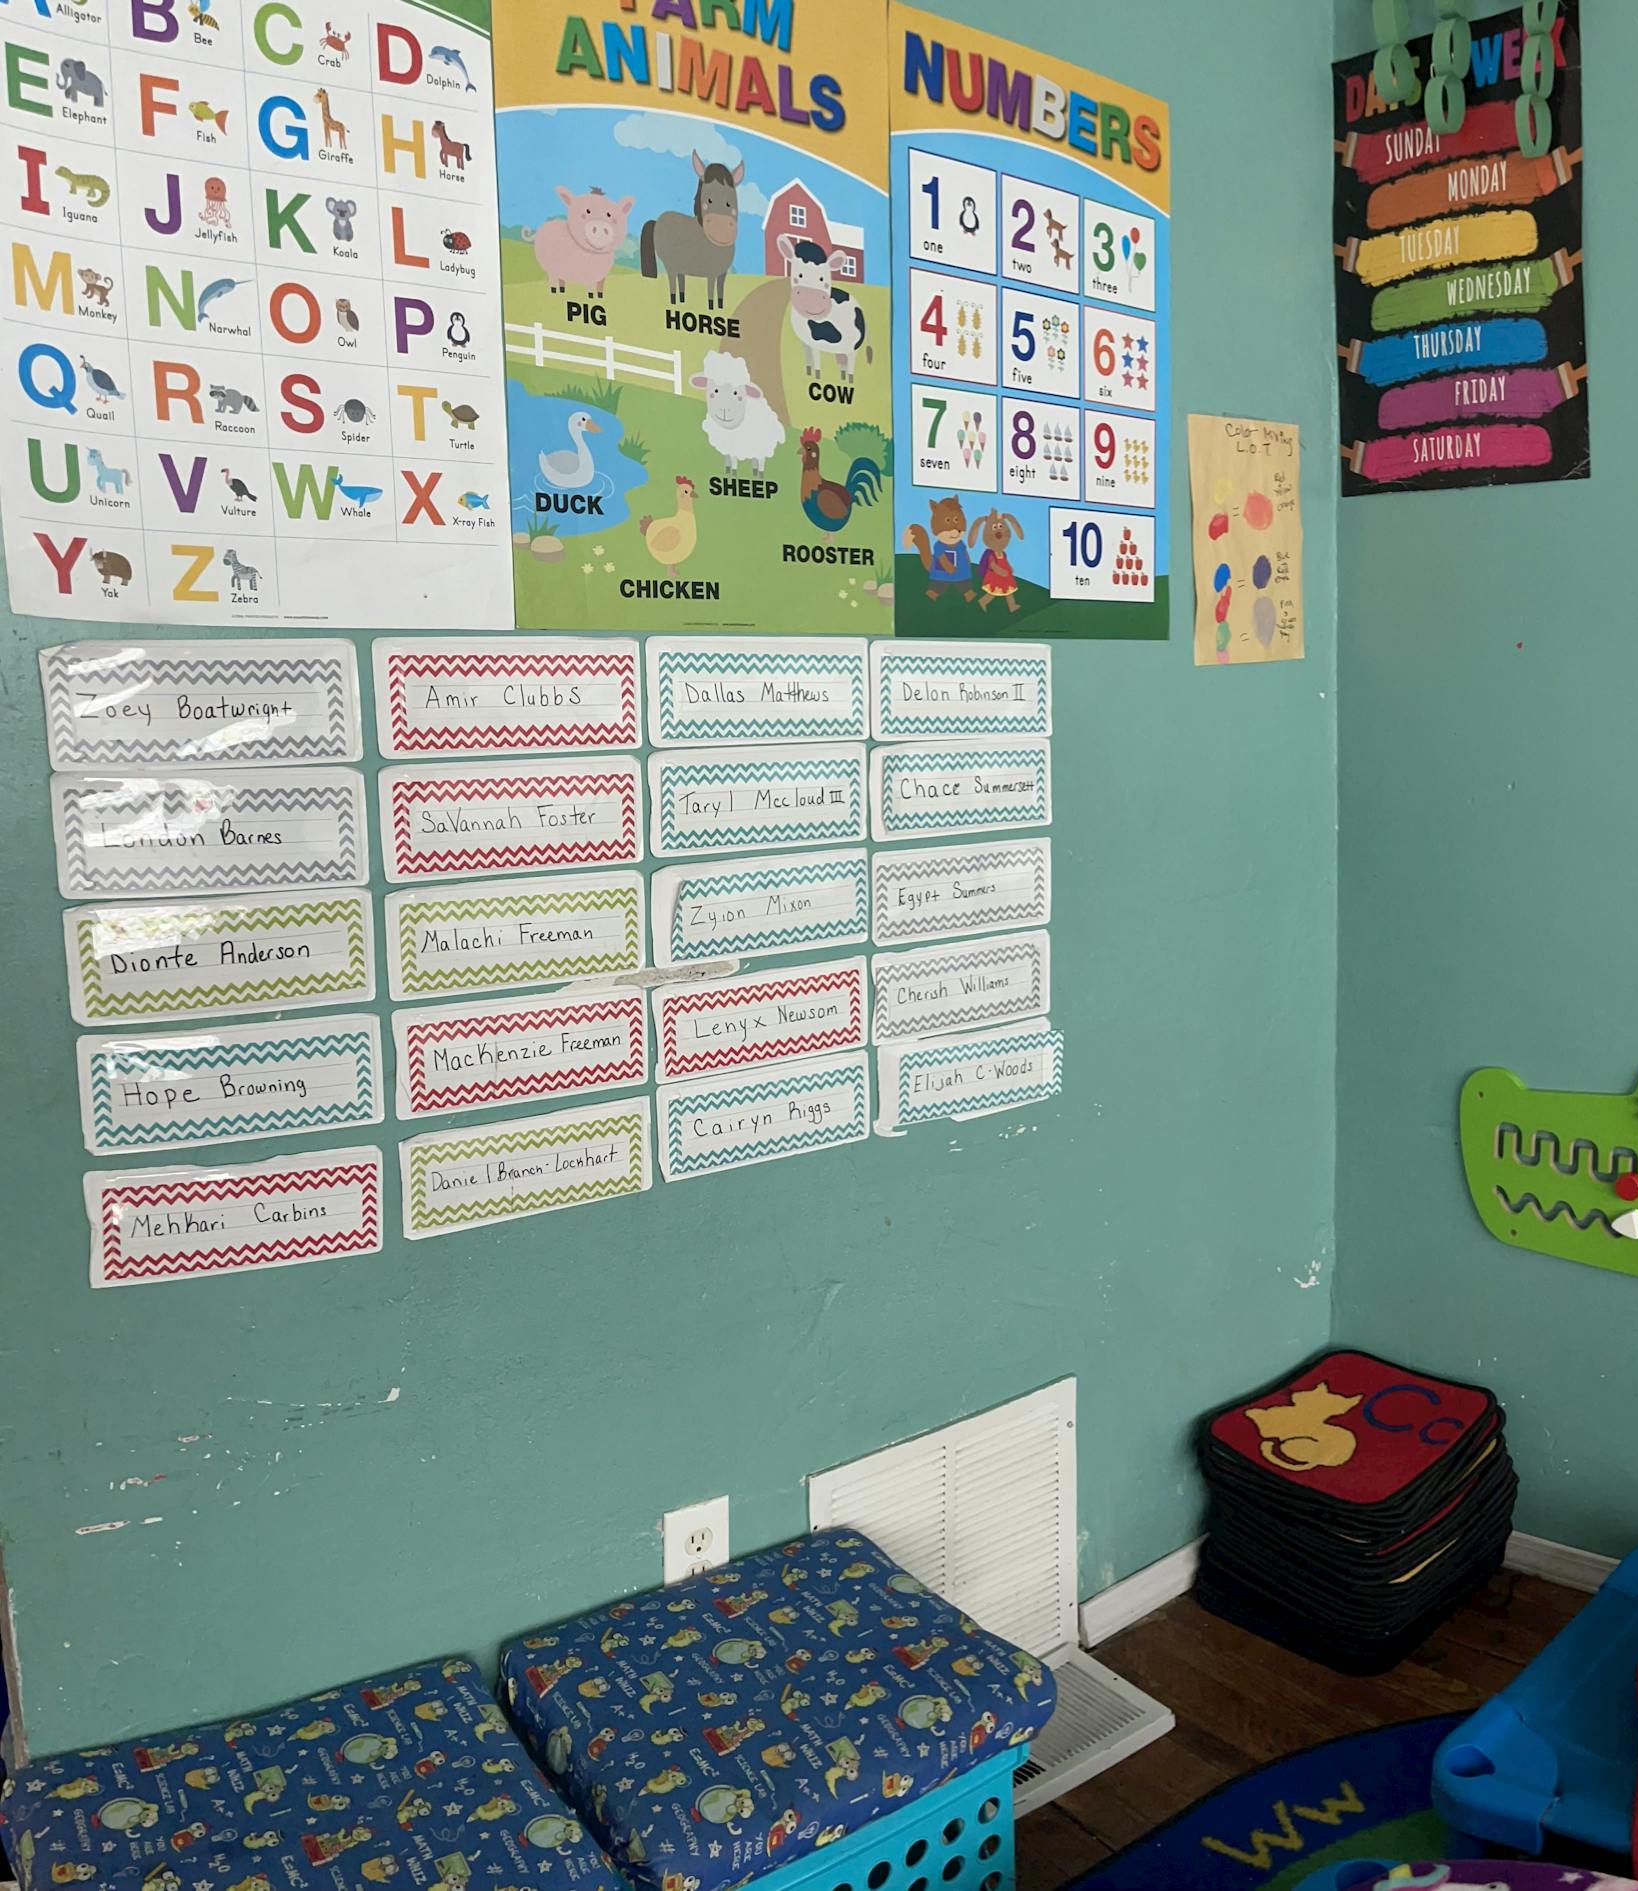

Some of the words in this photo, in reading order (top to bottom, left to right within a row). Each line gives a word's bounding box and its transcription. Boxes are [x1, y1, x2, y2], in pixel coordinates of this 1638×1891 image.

[56, 4, 102, 24] Alligator
[194, 34, 213, 46] Bee
[318, 55, 342, 68] Crab
[426, 74, 460, 92] Dolphin
[556, 16, 845, 132] ANIMALS
[903, 31, 1161, 171] NUMBERS
[62, 107, 107, 126] Elephant
[196, 131, 217, 144] Fish
[319, 150, 354, 165] Giraffe
[439, 170, 465, 183] Horse
[1448, 161, 1507, 202] MONDAY
[63, 206, 98, 224] Iguana
[195, 226, 238, 244] Jellyfish
[334, 247, 358, 259] Koala
[922, 240, 944, 254] one
[1400, 227, 1461, 263] TUESDAY
[440, 261, 476, 278] Ladybug
[1012, 259, 1032, 275] two
[1092, 278, 1118, 295] three
[1447, 267, 1531, 305] WEDNESDAY
[78, 306, 118, 325] Monkey
[567, 301, 607, 328] PIG
[209, 323, 252, 338] Narwhal
[665, 310, 741, 339] HORSE
[338, 336, 357, 348] Owl
[1413, 327, 1482, 359] THURSDAY
[442, 347, 476, 362] Penguin
[922, 355, 946, 371] four
[1012, 369, 1032, 385] five
[808, 382, 854, 405] COW
[1099, 386, 1112, 398] six
[1455, 376, 1506, 405] FRIDAY
[86, 408, 115, 422] Quail
[215, 421, 256, 434] Raccoon
[342, 431, 370, 444] Spider
[450, 439, 474, 450] Turtle
[1412, 432, 1481, 463] SATURDAY
[920, 458, 950, 470] seven
[1009, 464, 1036, 484] eight
[1096, 475, 1116, 489] nine
[709, 476, 778, 499] SHEEP
[90, 496, 130, 509] Unicorn
[221, 505, 256, 517] Vulture
[340, 506, 372, 518] Whale
[536, 492, 604, 515] DUCK
[452, 516, 475, 530] X-ray
[478, 517, 495, 528] Fish
[1062, 521, 1102, 568] 10
[783, 544, 875, 566] ROOSTER
[619, 579, 720, 600] CHICKEN
[1075, 574, 1090, 586] ten
[102, 587, 119, 598] Yak
[231, 592, 258, 604] Zebra
[426, 685, 478, 709] Amir
[685, 682, 745, 704] Dallas
[761, 682, 829, 703] Matthews
[903, 681, 950, 702] Delon
[76, 693, 152, 726] Zoey
[537, 805, 596, 827] Foster
[220, 819, 282, 845] Barnes
[767, 895, 811, 915] Mixon
[421, 927, 503, 953] Malachi
[520, 923, 593, 945] Freeman
[111, 946, 198, 974] Dionte
[221, 941, 310, 965] Anderson
[960, 974, 1009, 995] Williams
[694, 1015, 767, 1042] Lenyx
[778, 1005, 838, 1025] Newsom
[561, 1033, 621, 1053] Freeman
[914, 1069, 963, 1093] Elijah
[123, 1082, 200, 1109] Hope
[220, 1074, 307, 1098] Browning
[789, 1101, 831, 1125] Riggs
